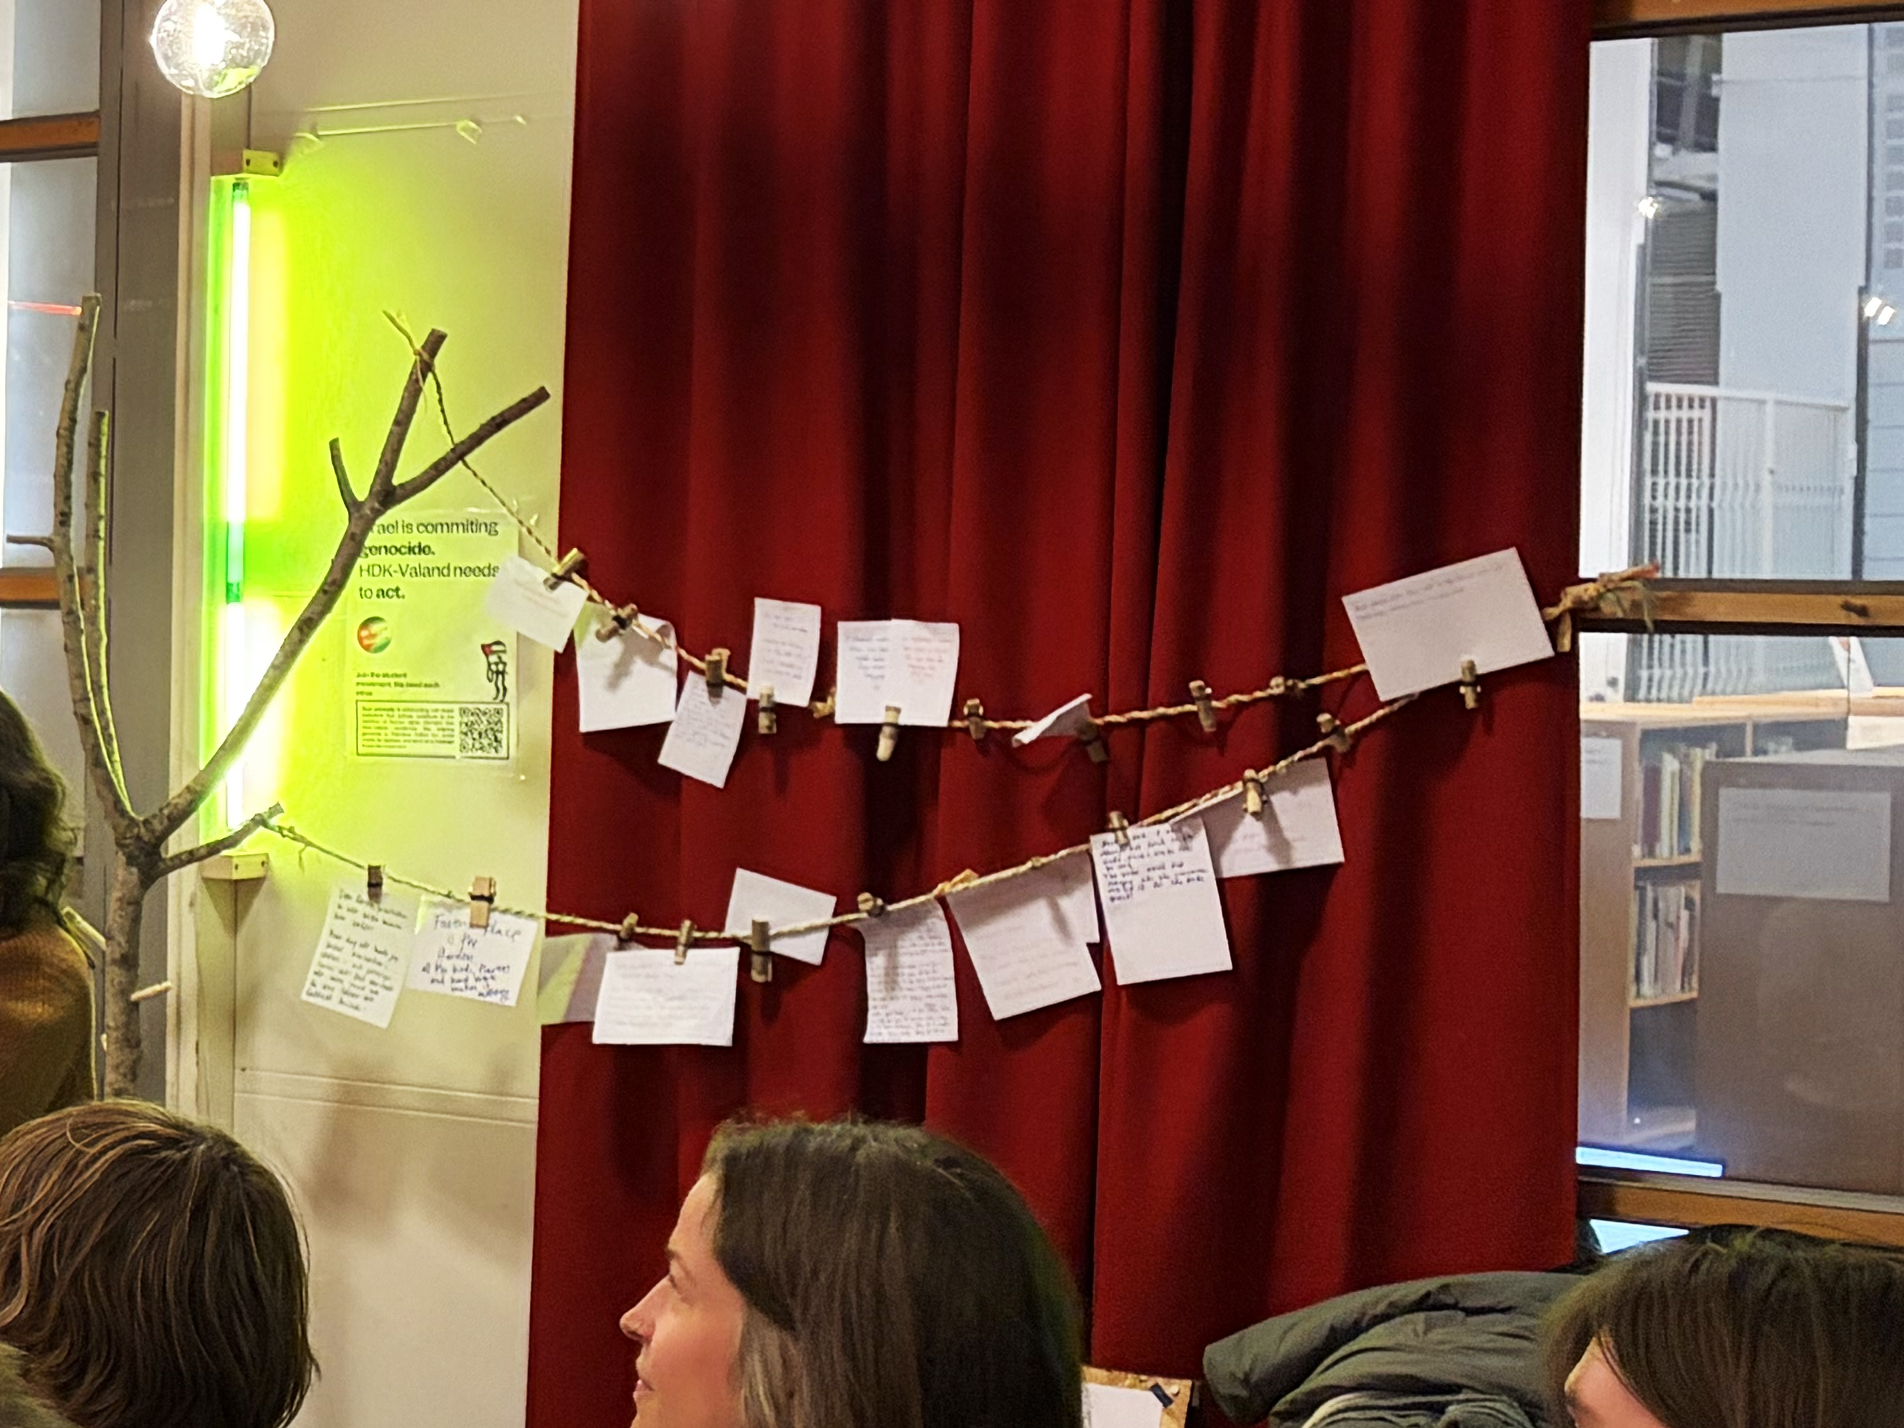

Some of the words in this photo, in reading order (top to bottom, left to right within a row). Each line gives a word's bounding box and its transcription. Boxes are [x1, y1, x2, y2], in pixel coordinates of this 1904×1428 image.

[401, 519, 414, 534] is
[415, 519, 500, 537] commiting
[360, 540, 436, 559] genocide.
[359, 562, 451, 578] HDK-Valand
[359, 585, 373, 600] to
[375, 585, 406, 600] act.
